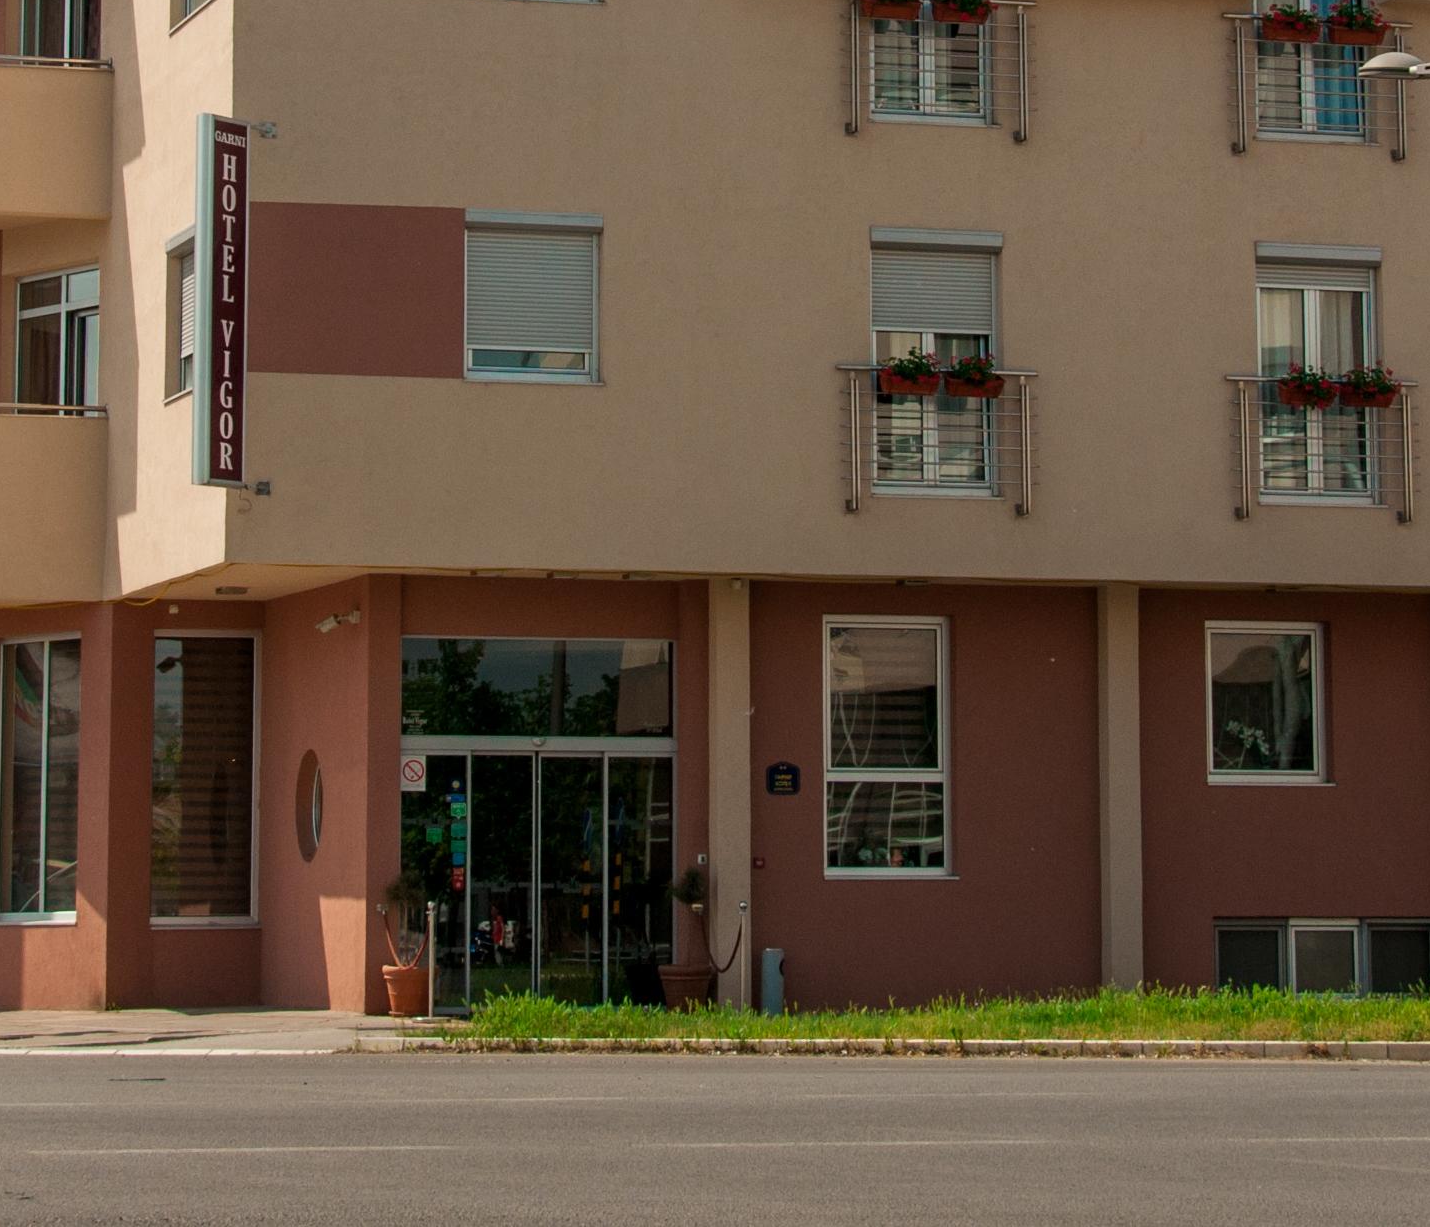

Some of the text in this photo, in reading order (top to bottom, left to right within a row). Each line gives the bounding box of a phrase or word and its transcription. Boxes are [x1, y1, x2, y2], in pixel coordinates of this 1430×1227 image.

[214, 129, 247, 148] GARNI
[219, 153, 238, 471] HOTEL VIGOR
